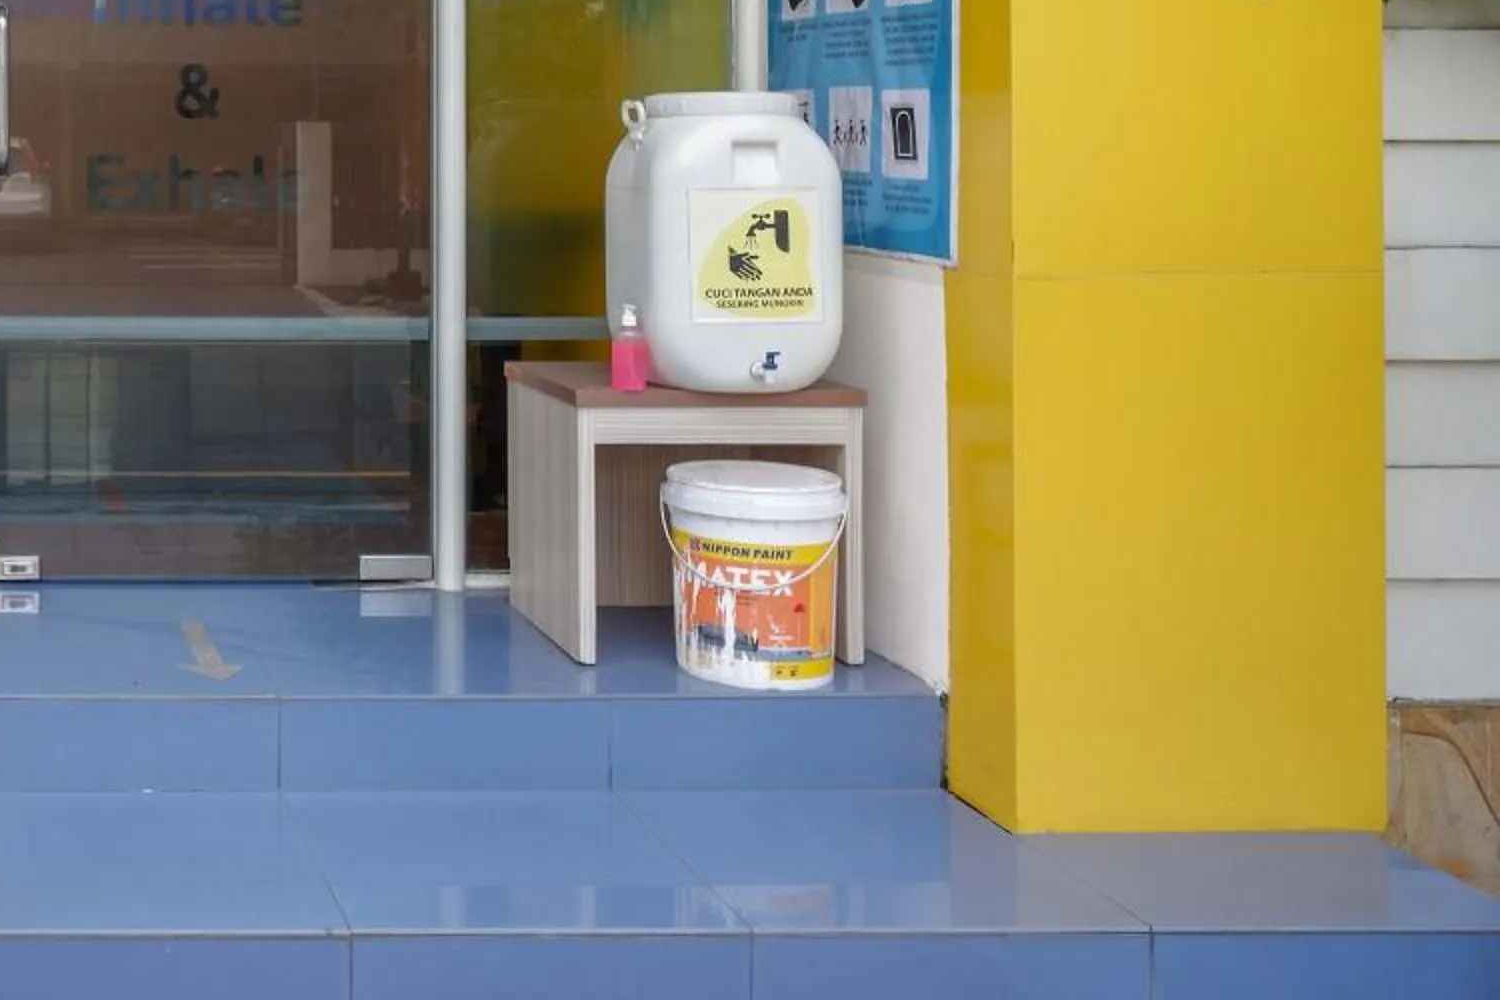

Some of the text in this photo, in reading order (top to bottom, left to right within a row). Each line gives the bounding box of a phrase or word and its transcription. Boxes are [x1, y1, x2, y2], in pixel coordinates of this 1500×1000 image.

[174, 63, 221, 120] &
[705, 286, 813, 299] CUCI TANGAN ANDA
[703, 543, 793, 560] NIPPON PAINT
